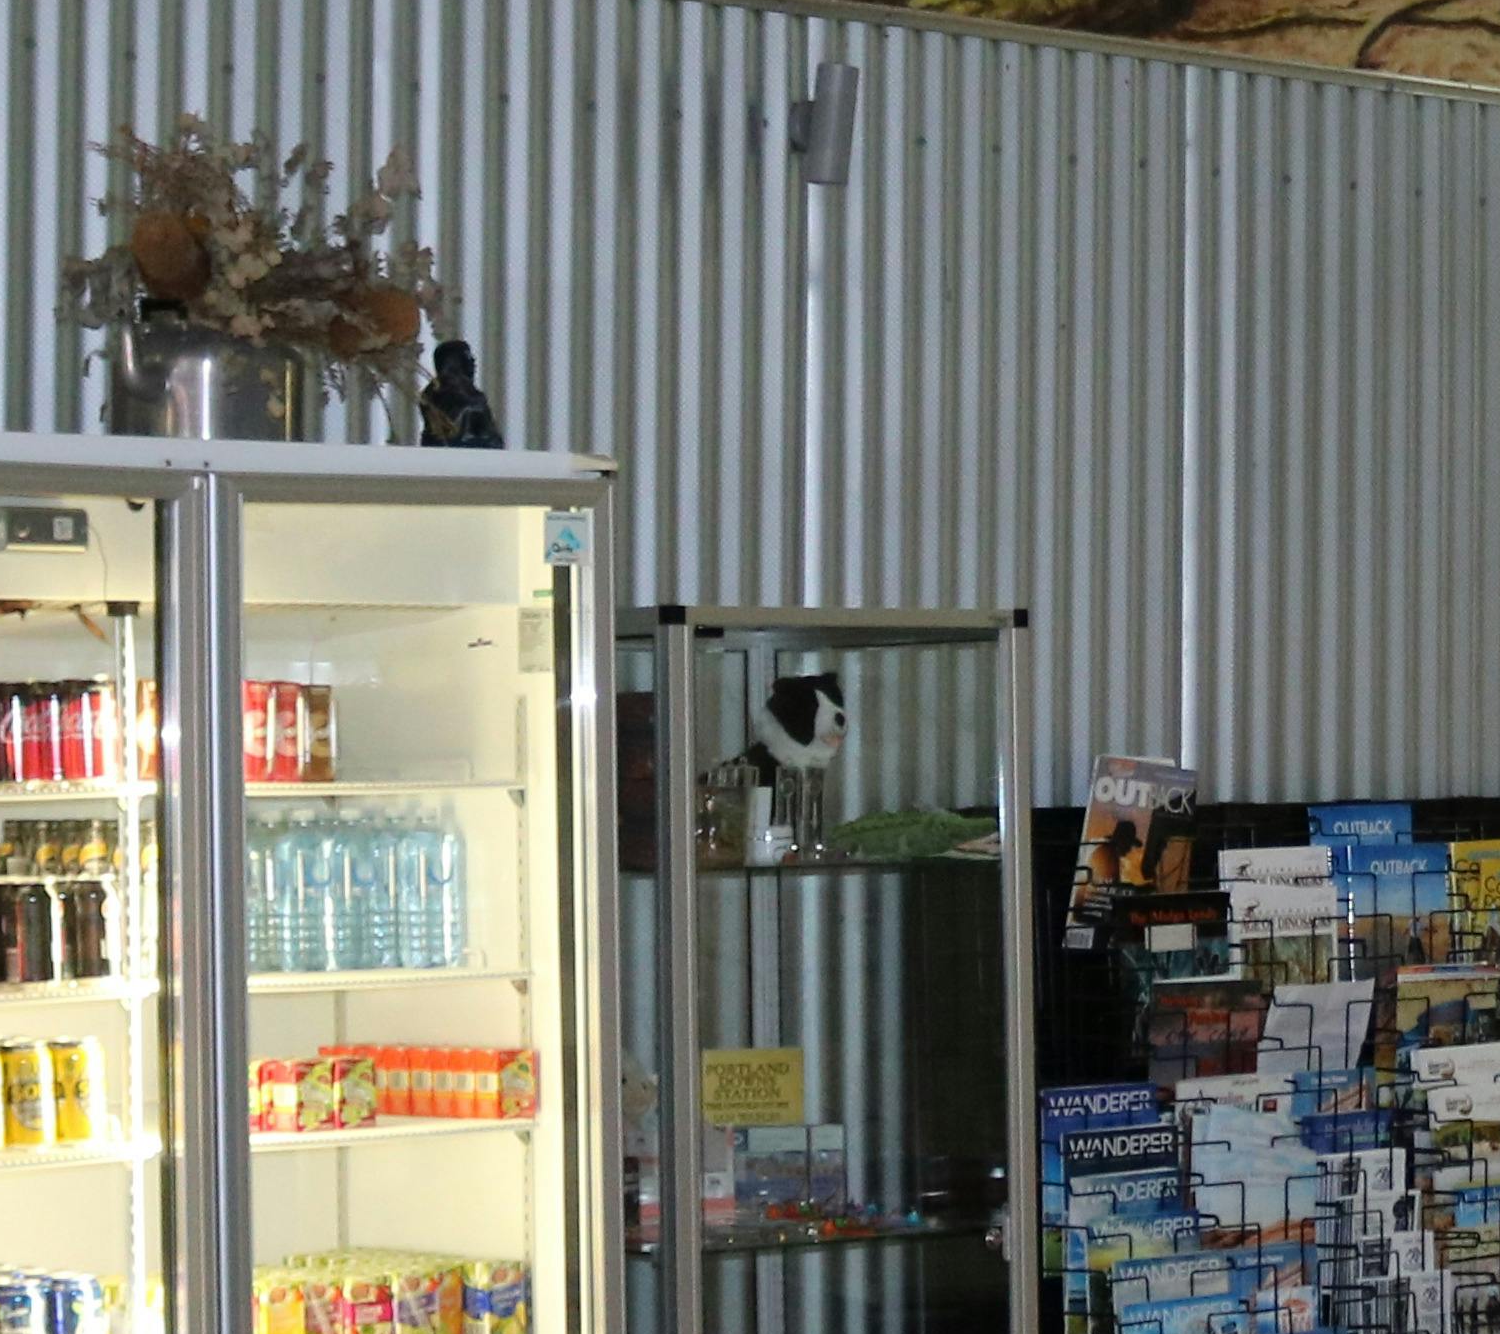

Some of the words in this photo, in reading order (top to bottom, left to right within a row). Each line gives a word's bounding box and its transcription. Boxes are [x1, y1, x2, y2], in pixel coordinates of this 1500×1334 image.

[1093, 776, 1194, 815] OUTBACK
[1333, 819, 1393, 836] OUTBACK
[1370, 858, 1427, 876] OUTBACK
[705, 1064, 790, 1076] PORTLAND
[714, 1088, 780, 1100] STATION
[1048, 1090, 1151, 1118] WANDERER
[1068, 1132, 1174, 1160] WANDERER
[1083, 1177, 1178, 1203] WANDERER
